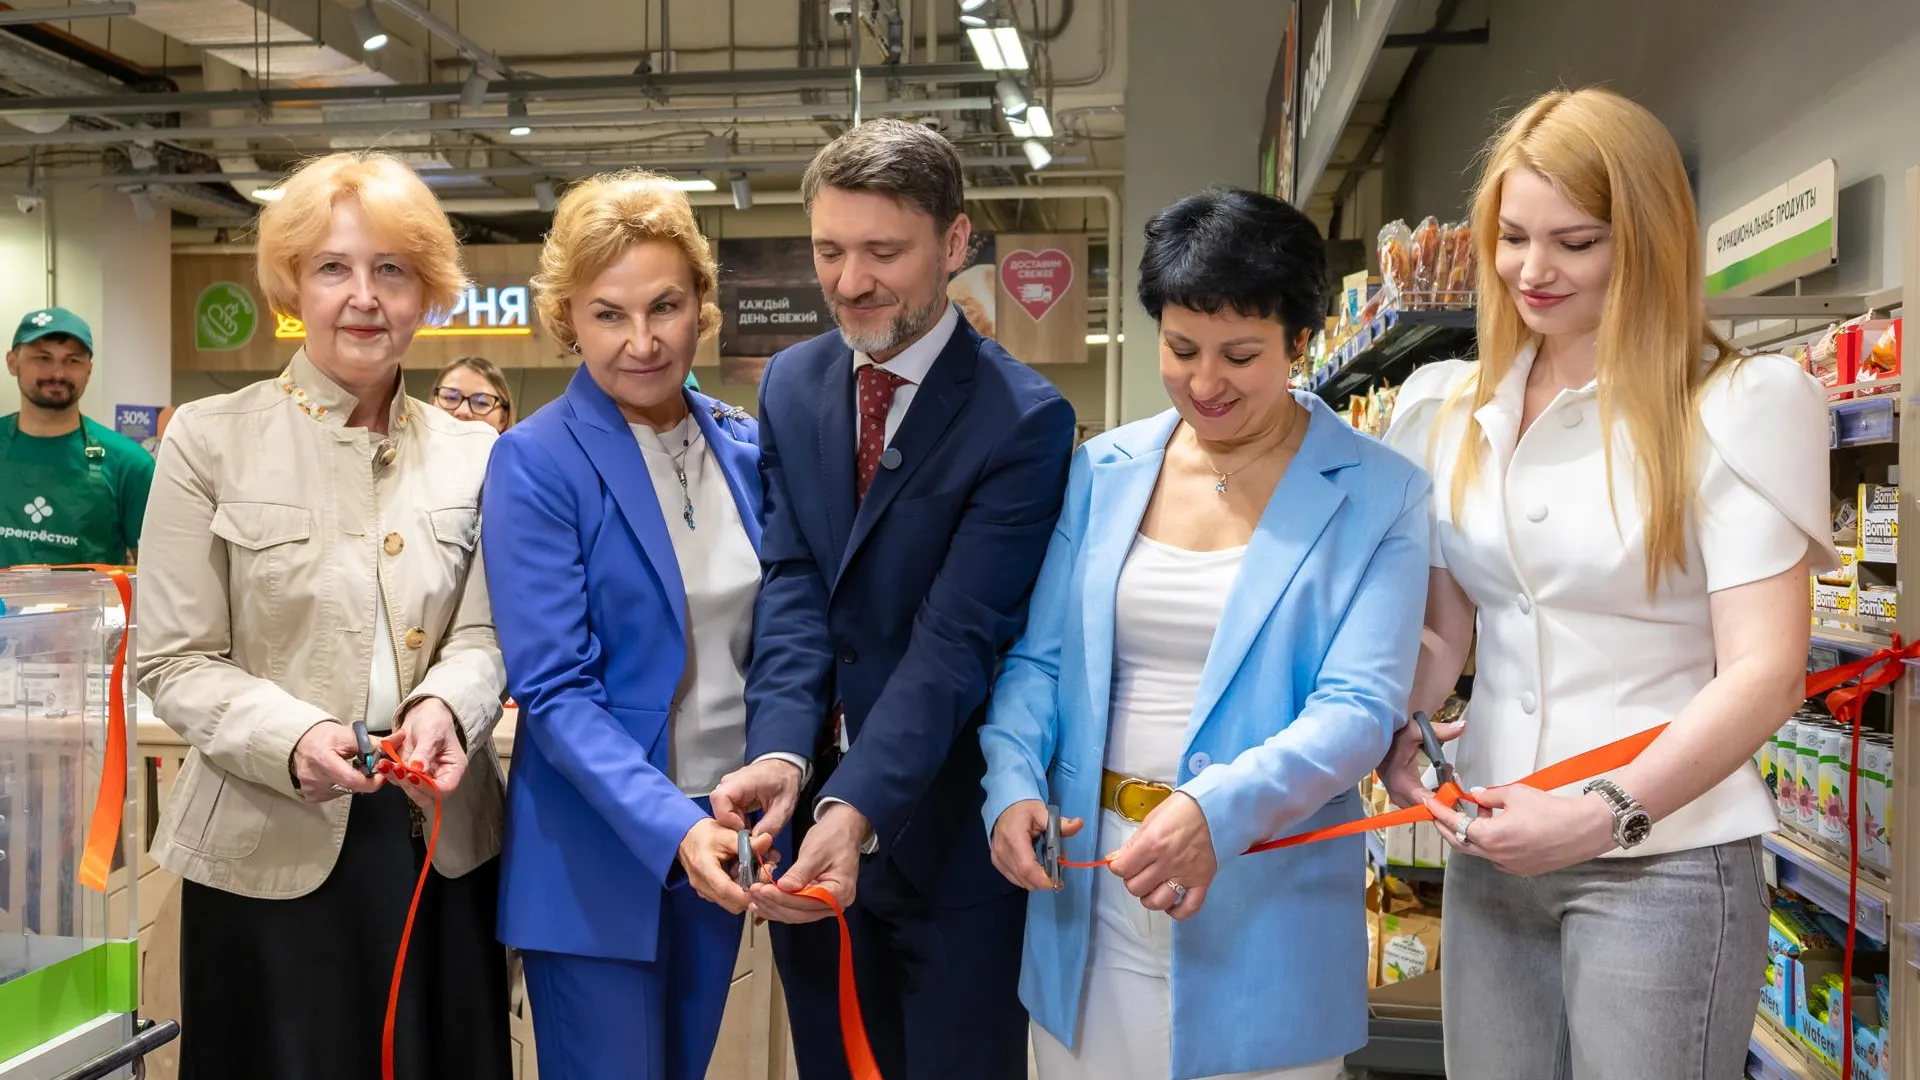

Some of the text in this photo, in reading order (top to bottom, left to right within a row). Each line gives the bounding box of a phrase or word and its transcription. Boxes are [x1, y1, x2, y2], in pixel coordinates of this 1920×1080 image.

[1716, 187, 1817, 253] ФУНКЦИОНАЛЬНЫЕ ПРОДУКТЫ
[1010, 260, 1062, 270] ДОСТАВИМ
[739, 297, 790, 310] КАЖДЫЙ
[739, 311, 818, 325] ДЕНЬ СВЕЖИЙ
[117, 410, 151, 425] -30%
[1816, 589, 1851, 610] Bombbar
[1801, 1015, 1836, 1059] Wafers
